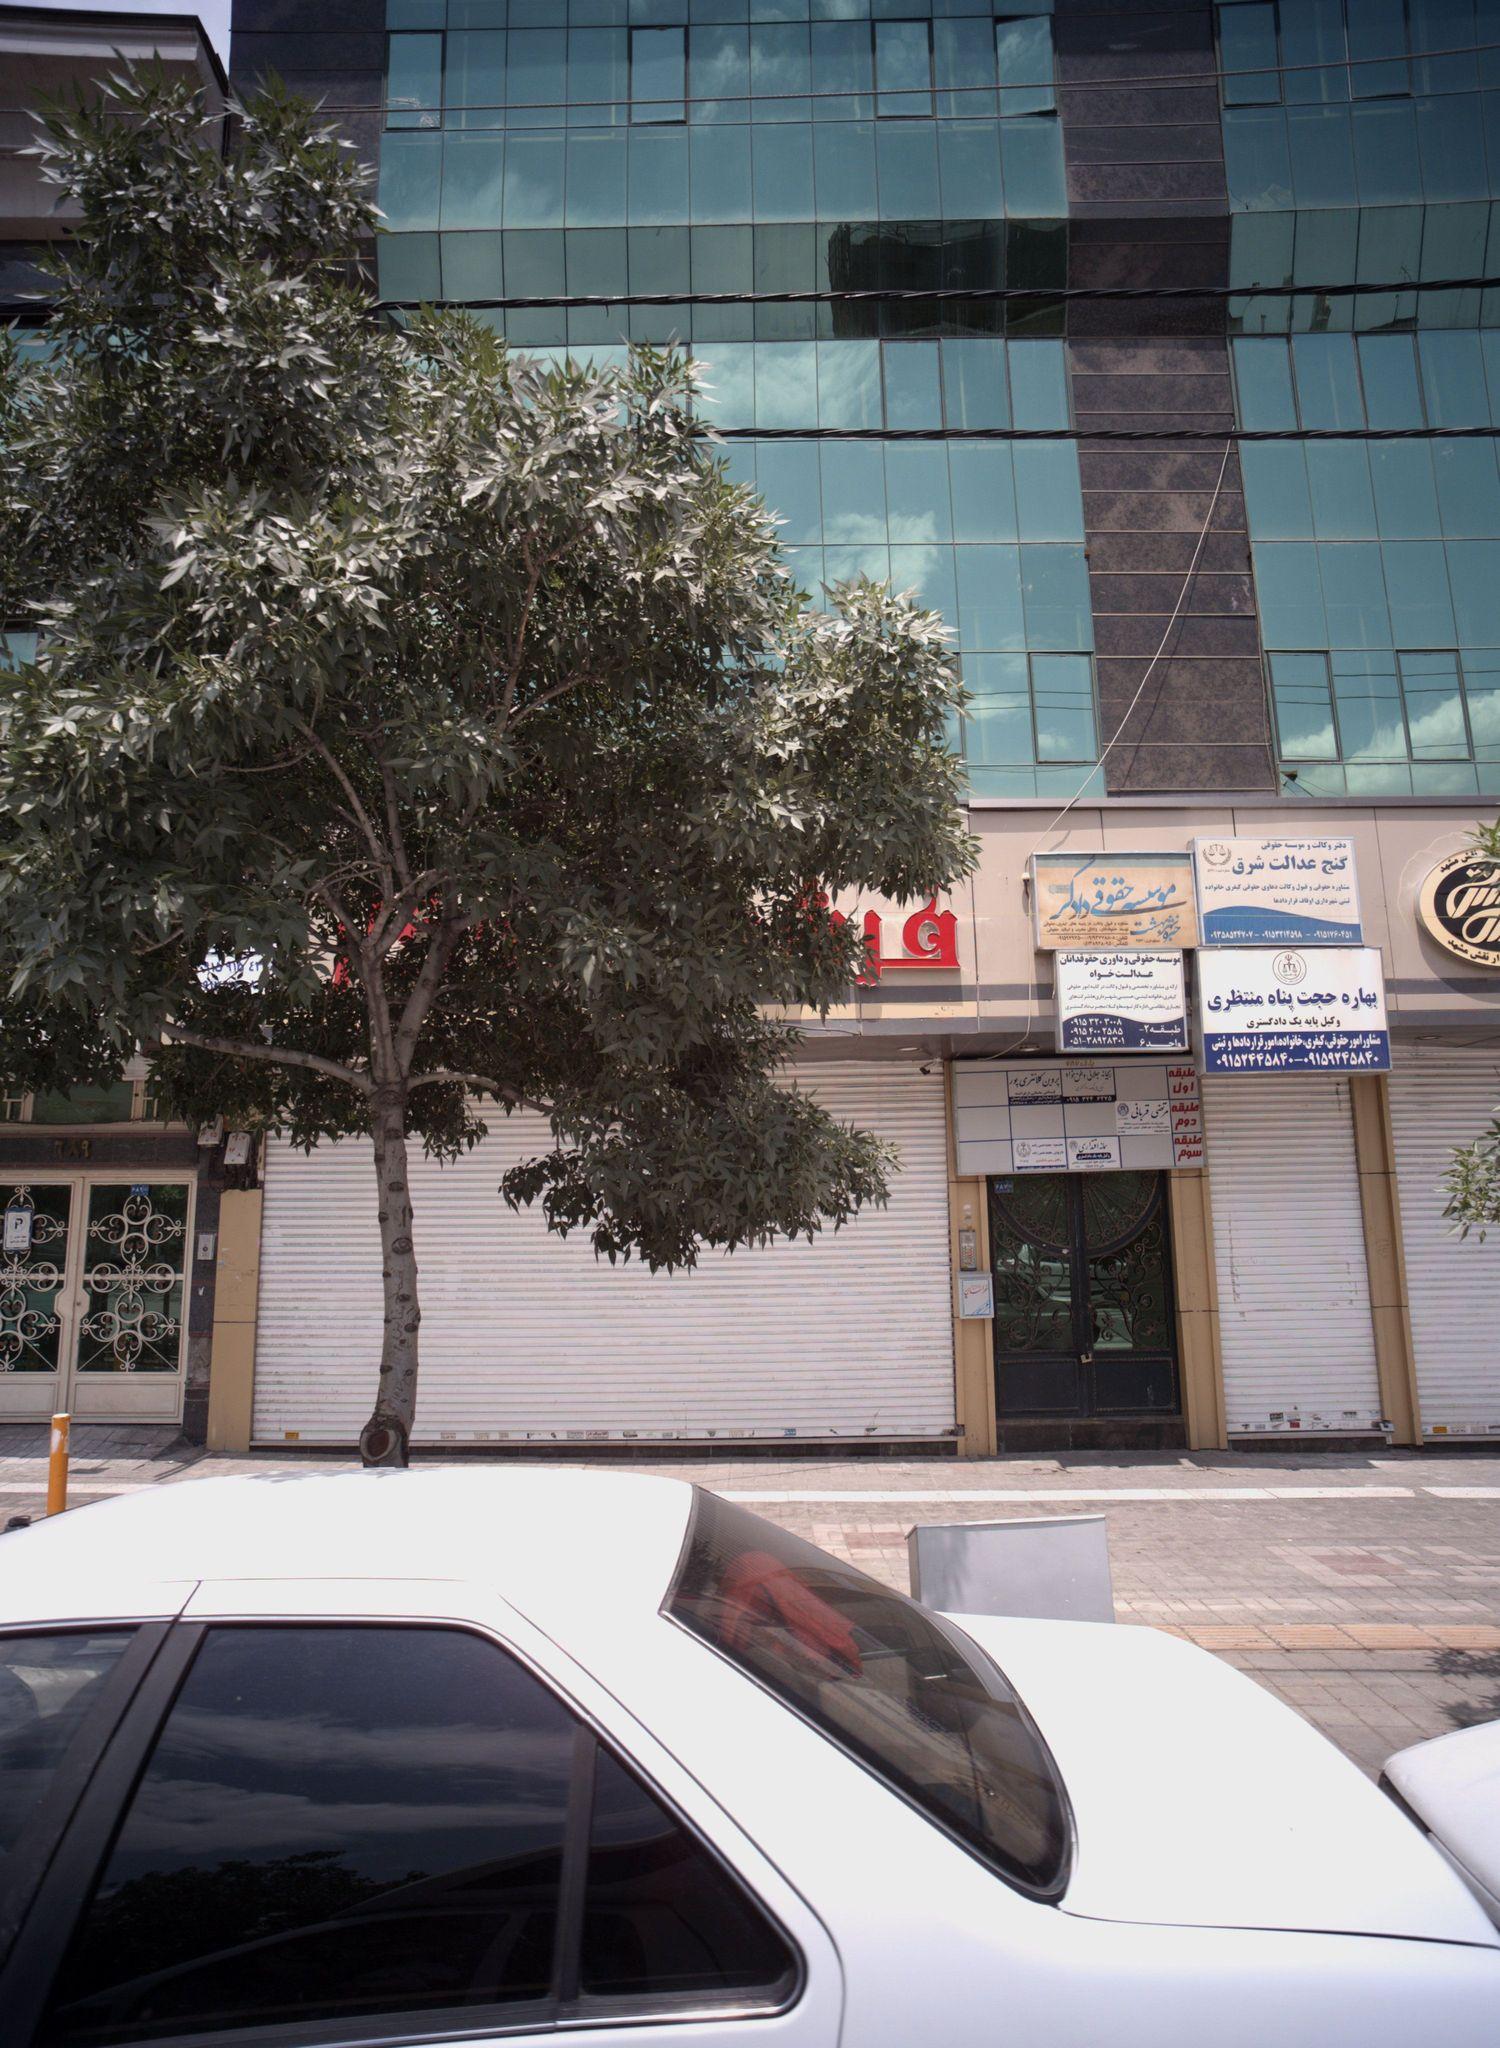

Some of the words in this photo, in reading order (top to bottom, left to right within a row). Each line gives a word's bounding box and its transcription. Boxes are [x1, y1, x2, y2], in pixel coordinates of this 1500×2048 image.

[1261, 842, 1283, 850] حقوقی
[1312, 842, 1331, 850] وکالت
[1334, 843, 1347, 851] دفتر
[1232, 855, 1265, 875] شرق
[1269, 854, 1317, 871] عدالت
[1321, 856, 1348, 875] گنج
[1440, 859, 1459, 873] مشهد
[1205, 884, 1224, 892] خانواده
[1279, 884, 1295, 892] وکالت
[1448, 939, 1468, 954] مشهد
[1060, 955, 1099, 966] حقوقدانان
[1100, 955, 1123, 965] داوری
[1128, 954, 1155, 966] حقوقی
[1156, 955, 1181, 966] موسسه
[1470, 951, 1489, 960] نقش
[1090, 969, 1114, 980] خواه
[1115, 969, 1153, 978] عدالت
[1207, 988, 1264, 1011] منتظری
[1268, 988, 1294, 1012] پناه
[1297, 990, 1337, 1009] حجت
[1341, 987, 1377, 1009] بهاره
[1246, 1017, 1287, 1029] دادگستری
[1289, 1017, 1302, 1027] یک
[1304, 1017, 1319, 1027] پایه
[1322, 1016, 1341, 1027] وکیل
[1212, 1035, 1226, 1051] ثبتی
[1232, 1035, 1264, 1050] قراردادها
[1349, 1034, 1362, 1048] امور
[1362, 1033, 1381, 1048] مشاور
[1169, 1067, 1195, 1079] طبقه
[1009, 1077, 1019, 1087] پور
[1020, 1072, 1047, 1087] کلانتری
[1042, 1077, 1060, 1087] پروین
[1173, 1082, 1194, 1094] اول
[1131, 1103, 1150, 1121] قربانی
[1151, 1102, 1169, 1119] مرتضی
[1171, 1102, 1200, 1114] طبقه
[1175, 1118, 1197, 1130] دوم
[1174, 1134, 1202, 1147] طبقه
[1178, 1149, 1202, 1161] سوم
